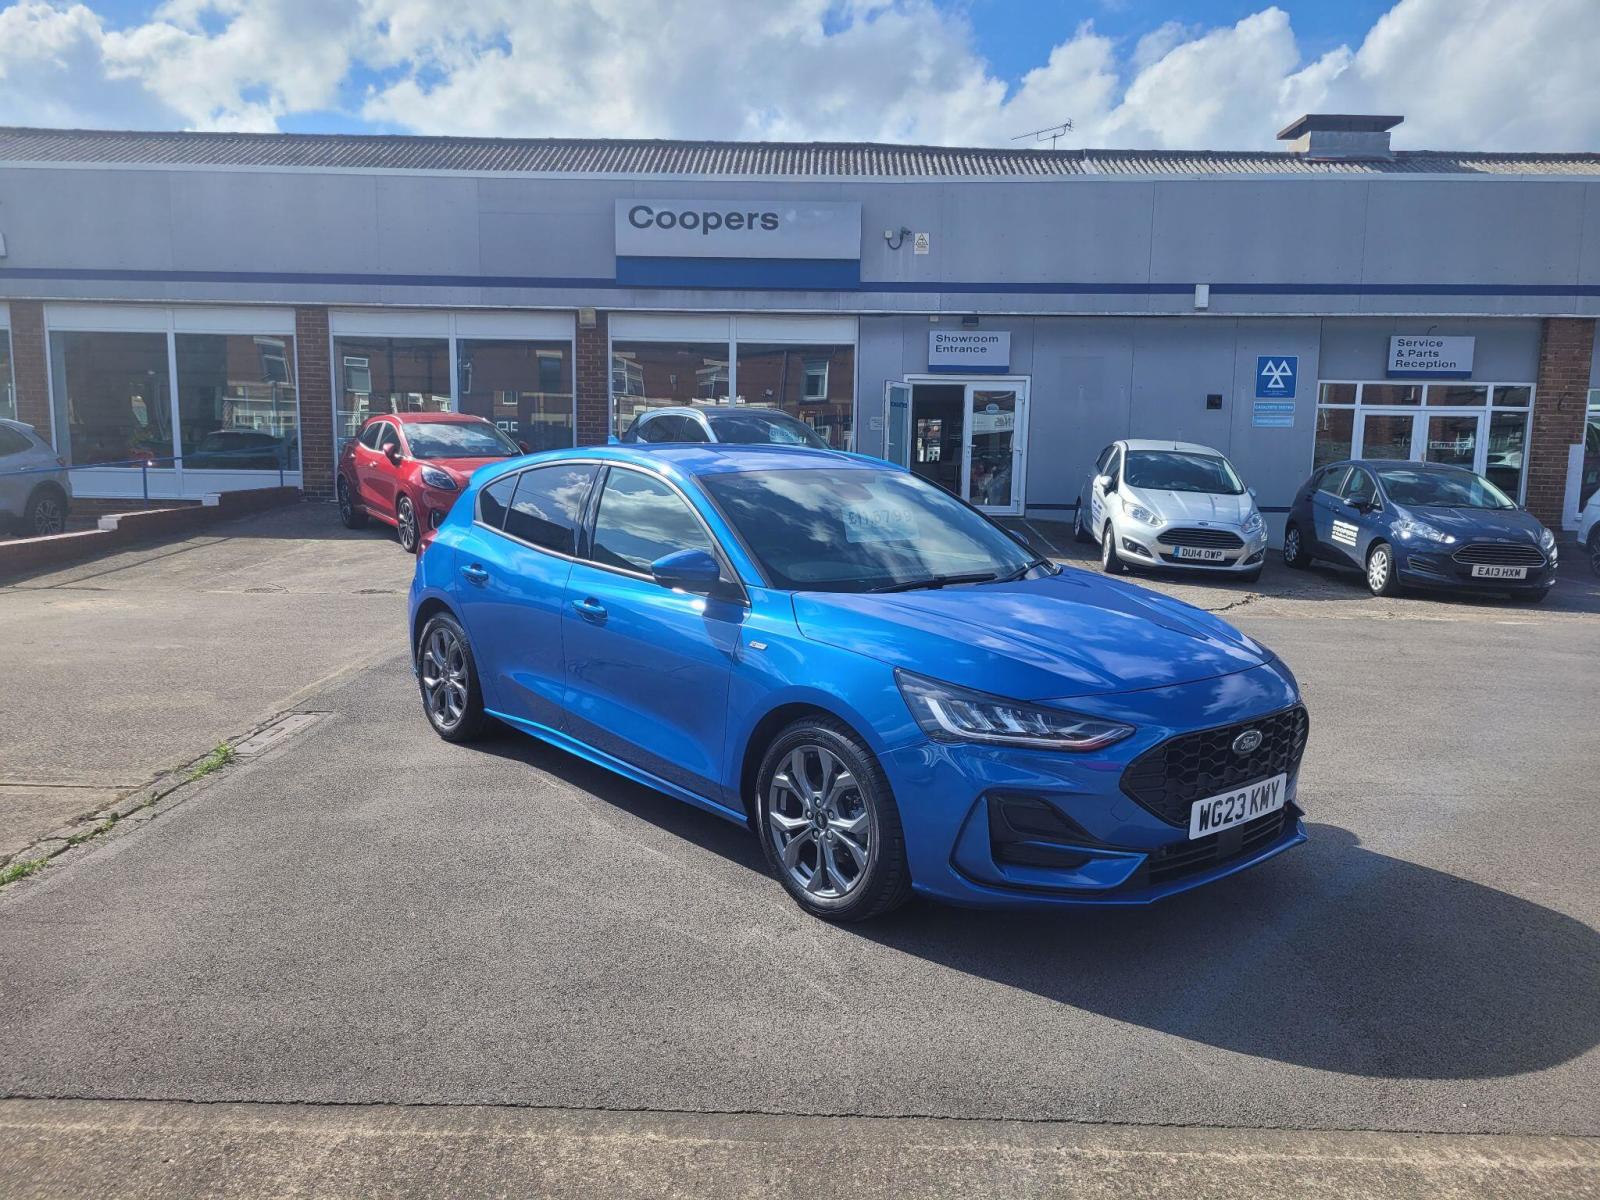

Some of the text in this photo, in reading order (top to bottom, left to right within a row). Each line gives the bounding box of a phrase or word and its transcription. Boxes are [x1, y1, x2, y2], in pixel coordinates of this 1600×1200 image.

[628, 205, 779, 235] Coopers
[935, 334, 999, 343] Showroom
[1397, 338, 1443, 347] Service
[935, 344, 987, 353] Entrance
[1396, 349, 1439, 358] & Parts
[1395, 360, 1456, 369] Reception
[1182, 548, 1222, 559] DU14 OWP
[1477, 566, 1500, 576] EA13
[1199, 780, 1280, 832] WG23 KMY
